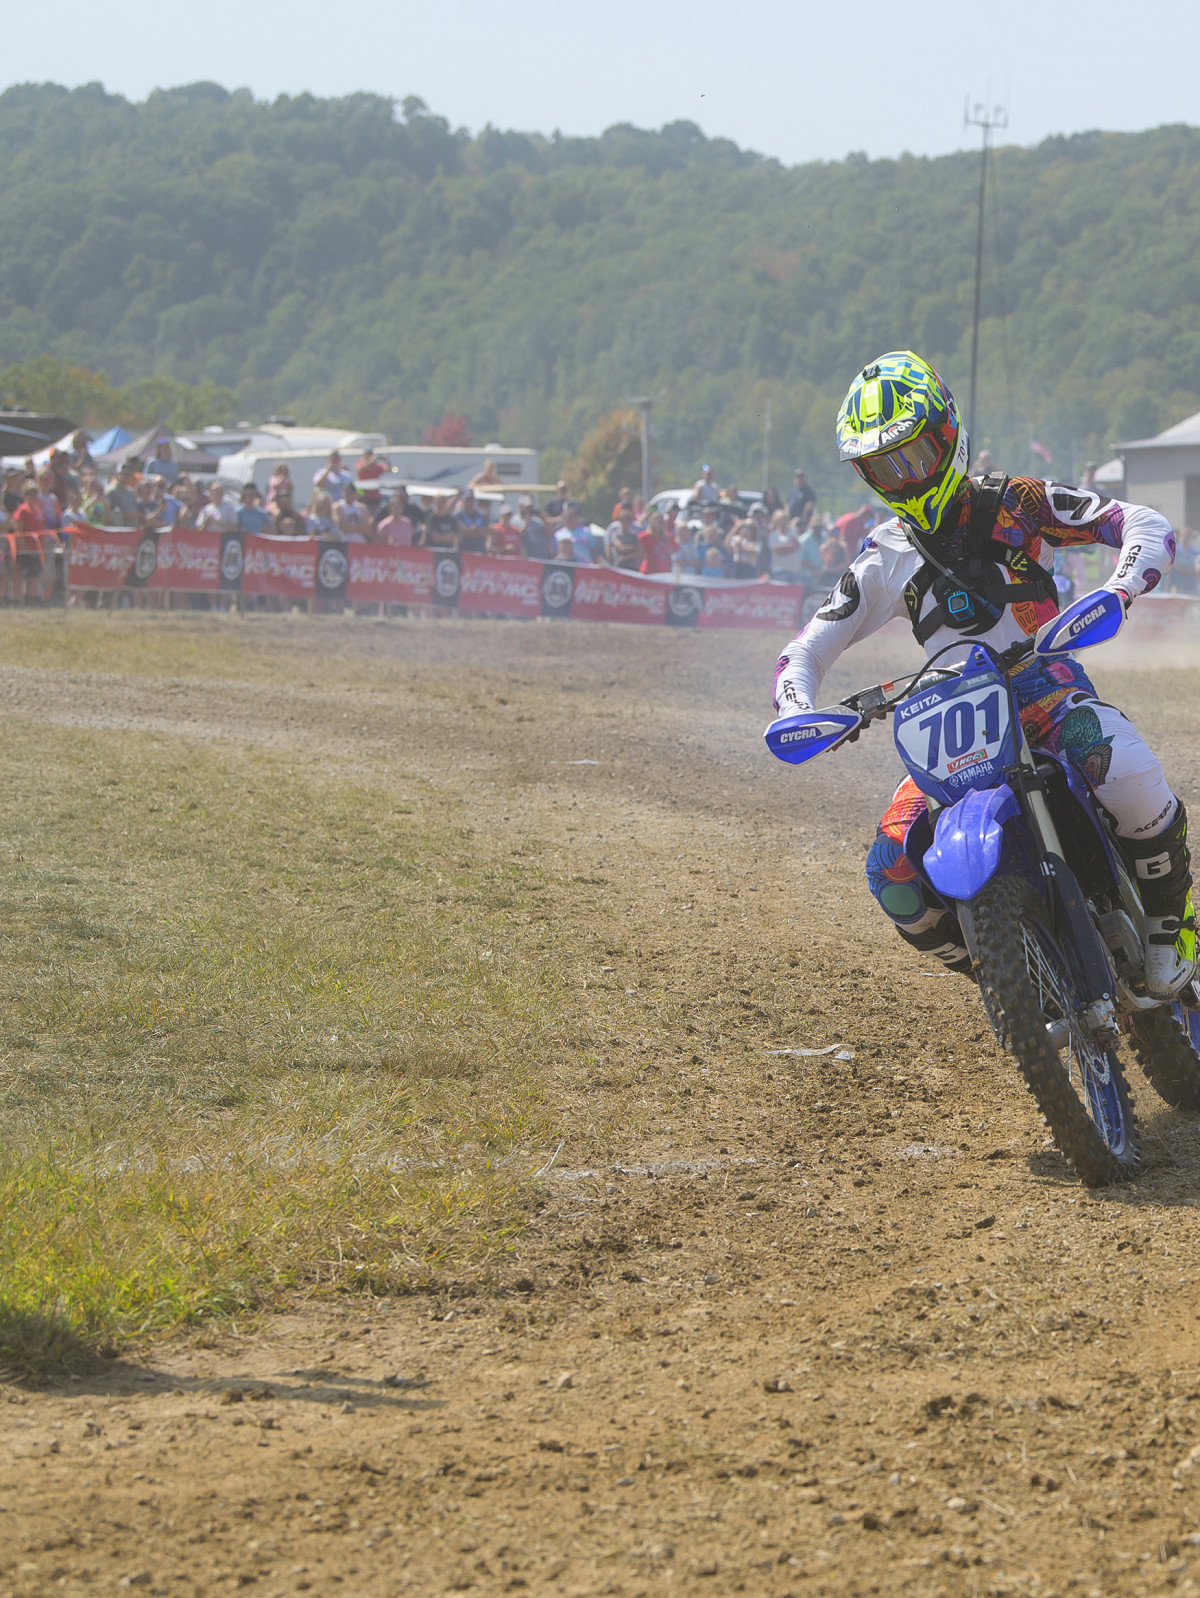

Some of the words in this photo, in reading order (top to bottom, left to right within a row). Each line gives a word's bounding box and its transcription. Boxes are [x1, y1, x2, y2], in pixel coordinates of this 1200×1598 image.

[881, 420, 914, 445] Airoh
[1072, 604, 1107, 633] CYCRA
[900, 693, 943, 720] KEITA
[780, 728, 817, 744] CYCRA
[918, 690, 1000, 773] 701
[957, 761, 994, 780] YAMAHA
